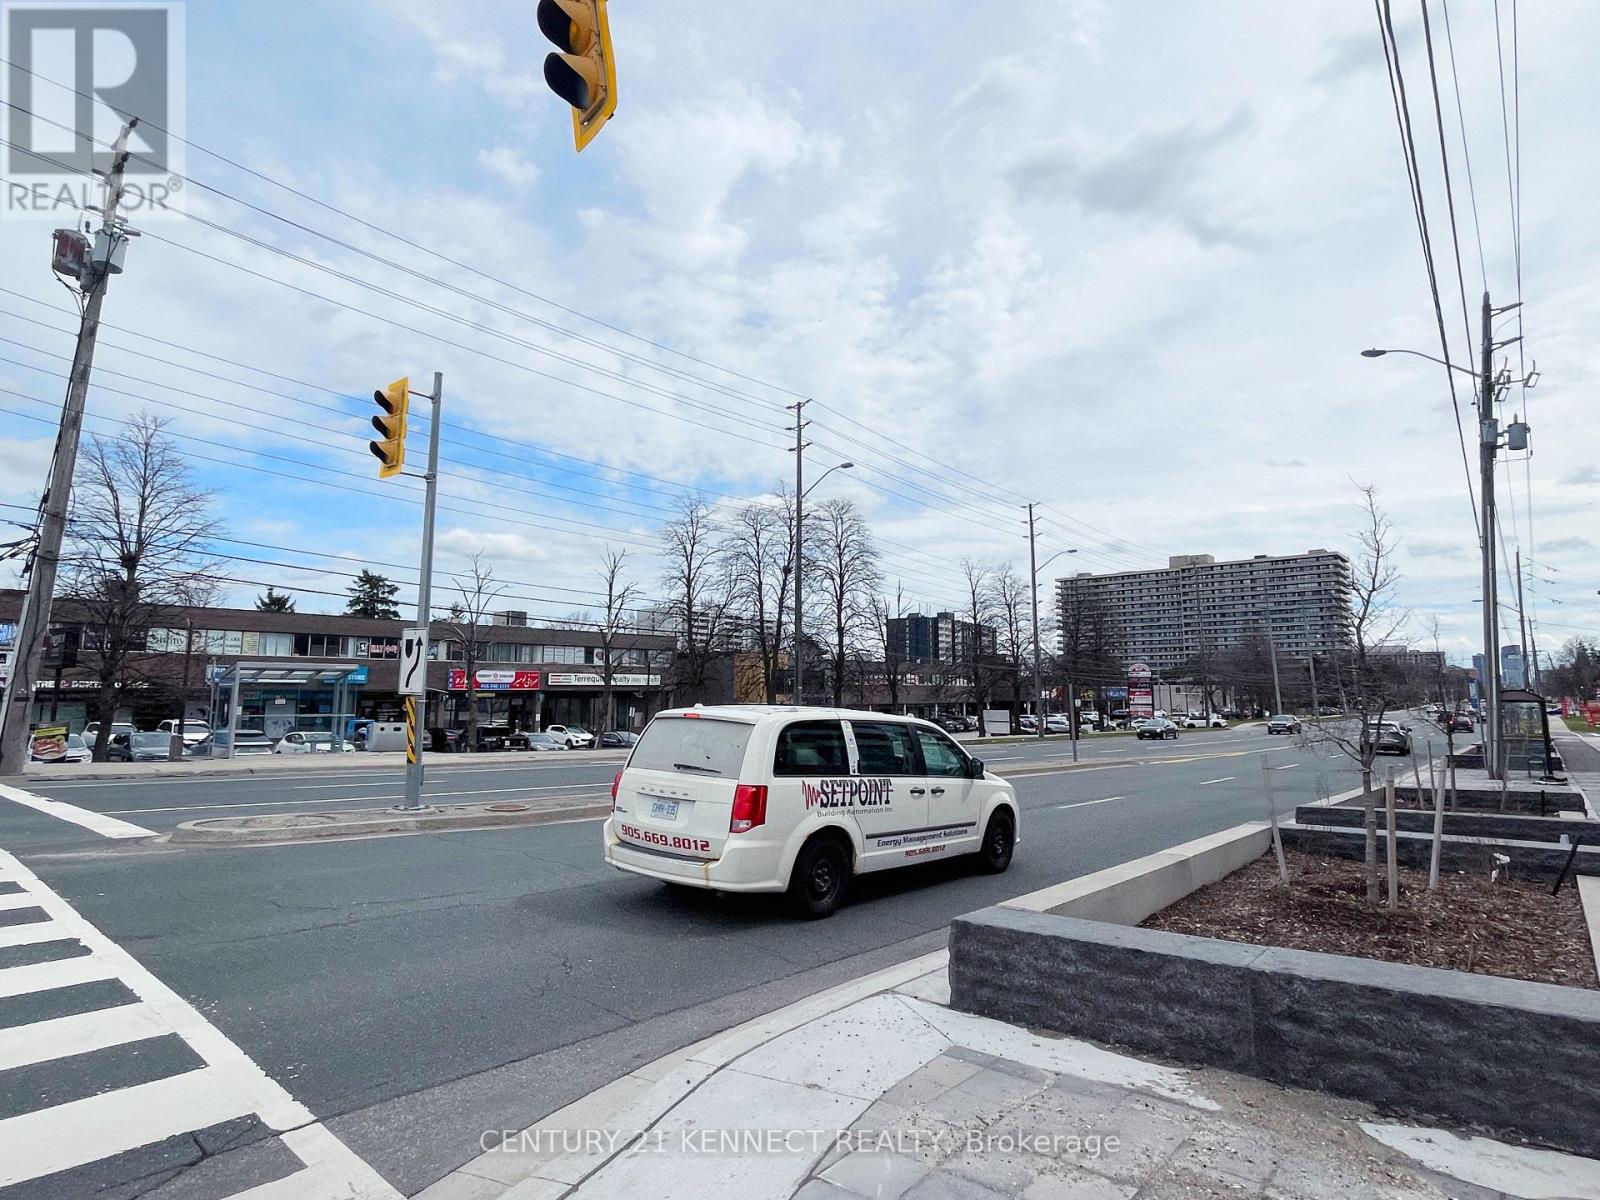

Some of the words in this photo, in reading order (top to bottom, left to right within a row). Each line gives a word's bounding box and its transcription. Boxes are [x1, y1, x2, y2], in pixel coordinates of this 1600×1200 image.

[820, 778, 892, 808] SETPOINT
[817, 809, 845, 818] Building
[621, 824, 710, 852] 905.669.8012
[877, 838, 902, 847] Energy
[903, 832, 942, 843] Management
[943, 829, 968, 838] Solutions
